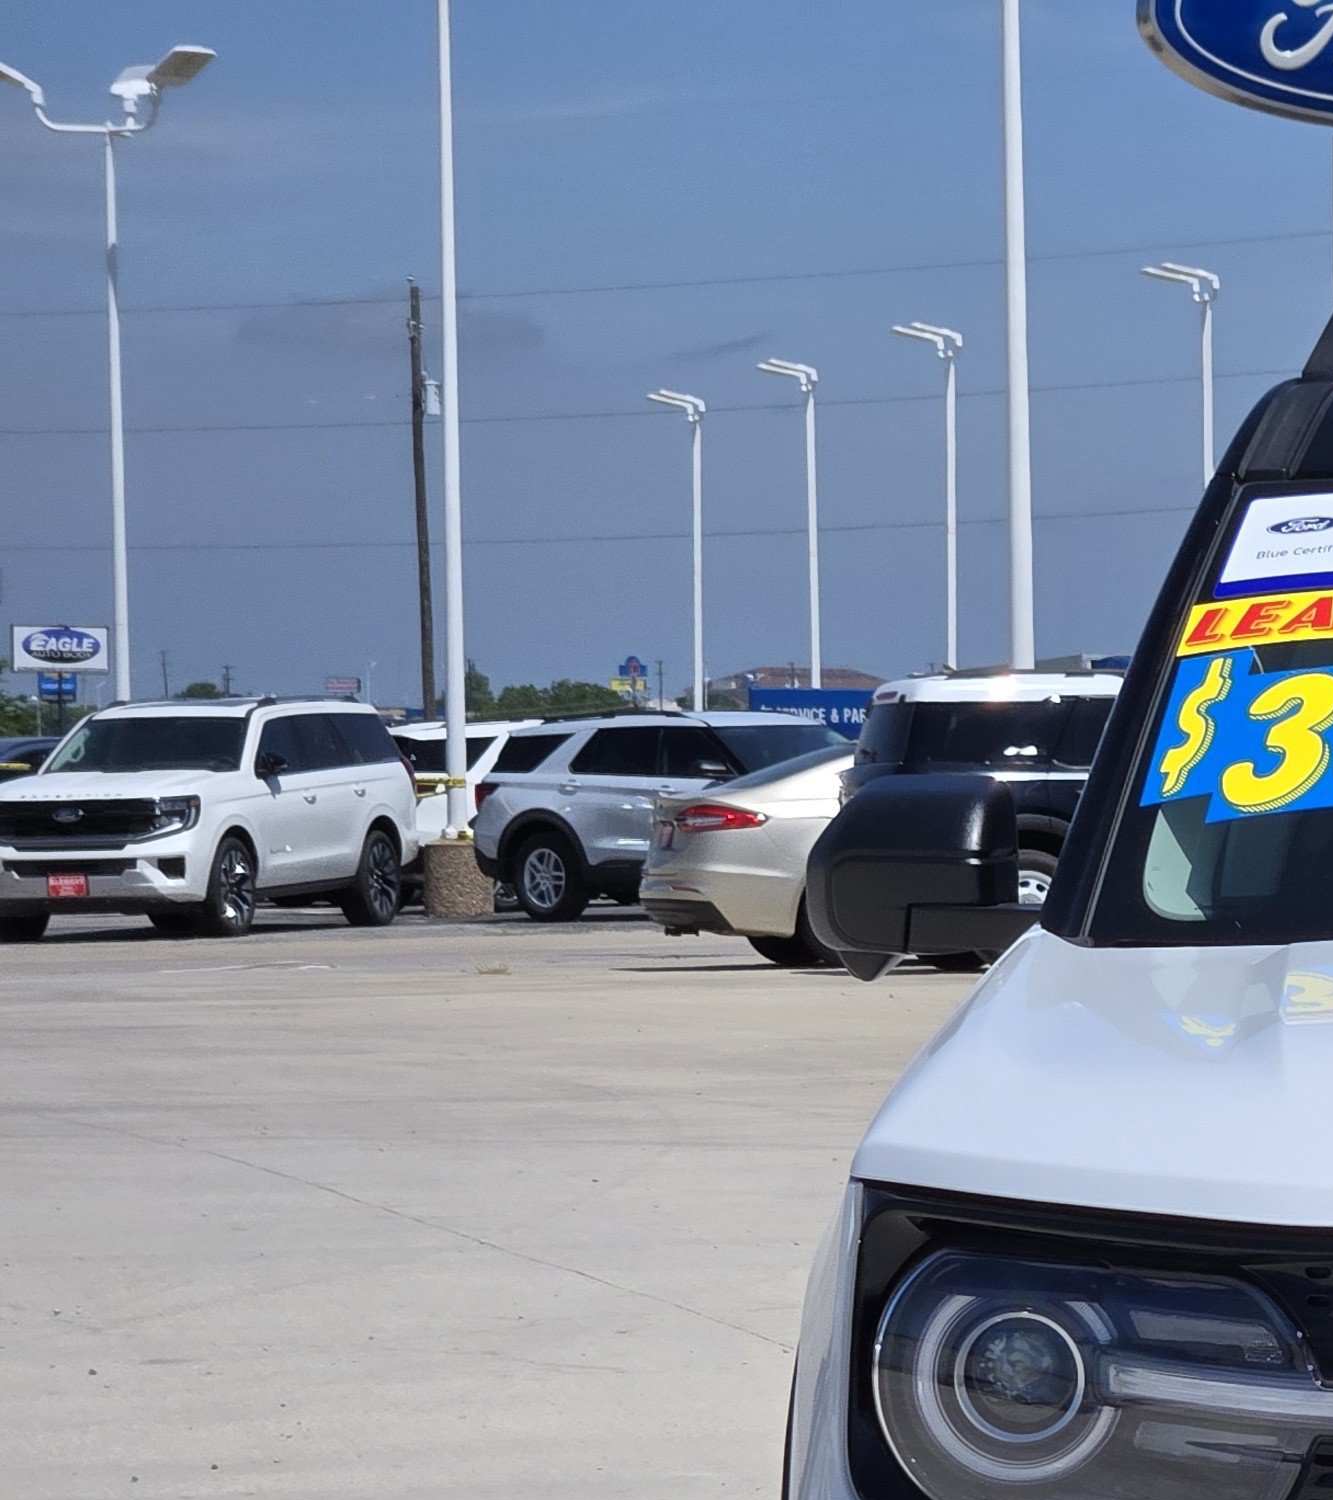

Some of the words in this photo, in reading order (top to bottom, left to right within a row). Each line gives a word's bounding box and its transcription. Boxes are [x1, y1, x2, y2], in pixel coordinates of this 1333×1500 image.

[1280, 517, 1331, 533] Ford
[1256, 548, 1289, 560] Blue
[29, 633, 95, 652] EAGLE
[830, 708, 840, 723] &
